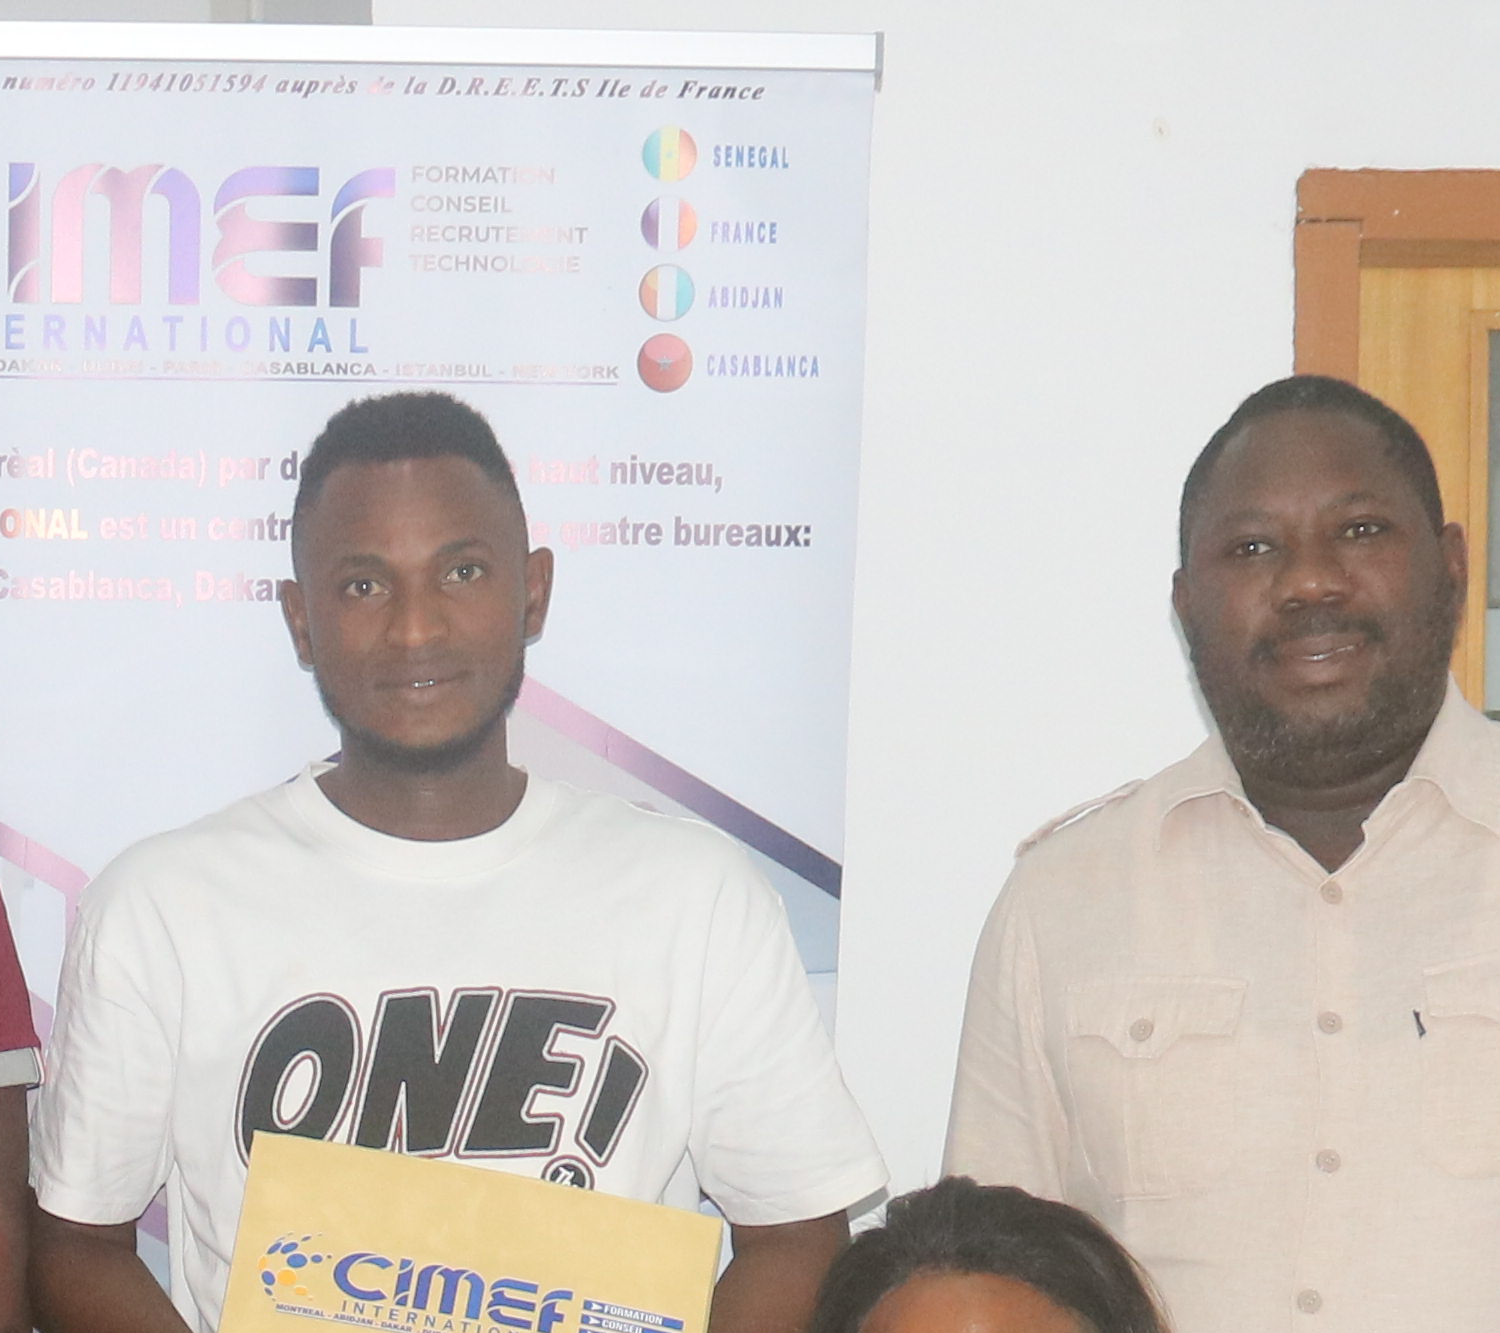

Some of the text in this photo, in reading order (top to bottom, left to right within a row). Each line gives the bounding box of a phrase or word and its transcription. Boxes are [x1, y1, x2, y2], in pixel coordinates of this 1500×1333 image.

[2, 71, 96, 93] numéro
[274, 75, 359, 99] auprès
[404, 76, 427, 96] la
[596, 78, 631, 99] Ile
[640, 78, 669, 99] de
[677, 80, 766, 101] France
[713, 145, 790, 169] SENEGAL
[411, 166, 556, 185] FORMATION
[411, 195, 513, 214] CONSEIL
[410, 224, 589, 245] RECRUTEMENT
[710, 221, 778, 244] FRANCE
[409, 254, 581, 274] TECHNOLOGIE
[707, 286, 784, 309] ABIDJAN
[237, 361, 377, 376] CASABLANCA
[396, 362, 493, 378] ISTANBUL
[706, 355, 821, 378] CASABLANCA
[66, 449, 206, 487] (Canada)
[218, 456, 271, 488] par
[528, 452, 600, 485] haut
[609, 456, 723, 494] niveau,
[101, 511, 149, 541] est
[159, 515, 197, 541] un
[560, 515, 663, 552] quatre
[673, 517, 812, 548] bureaux:
[275, 1303, 326, 1318] MONTREAL
[333, 1313, 374, 1327] ABIDJAN
[380, 1321, 413, 1333] DAKAR
[603, 1305, 664, 1326] FORMATION
